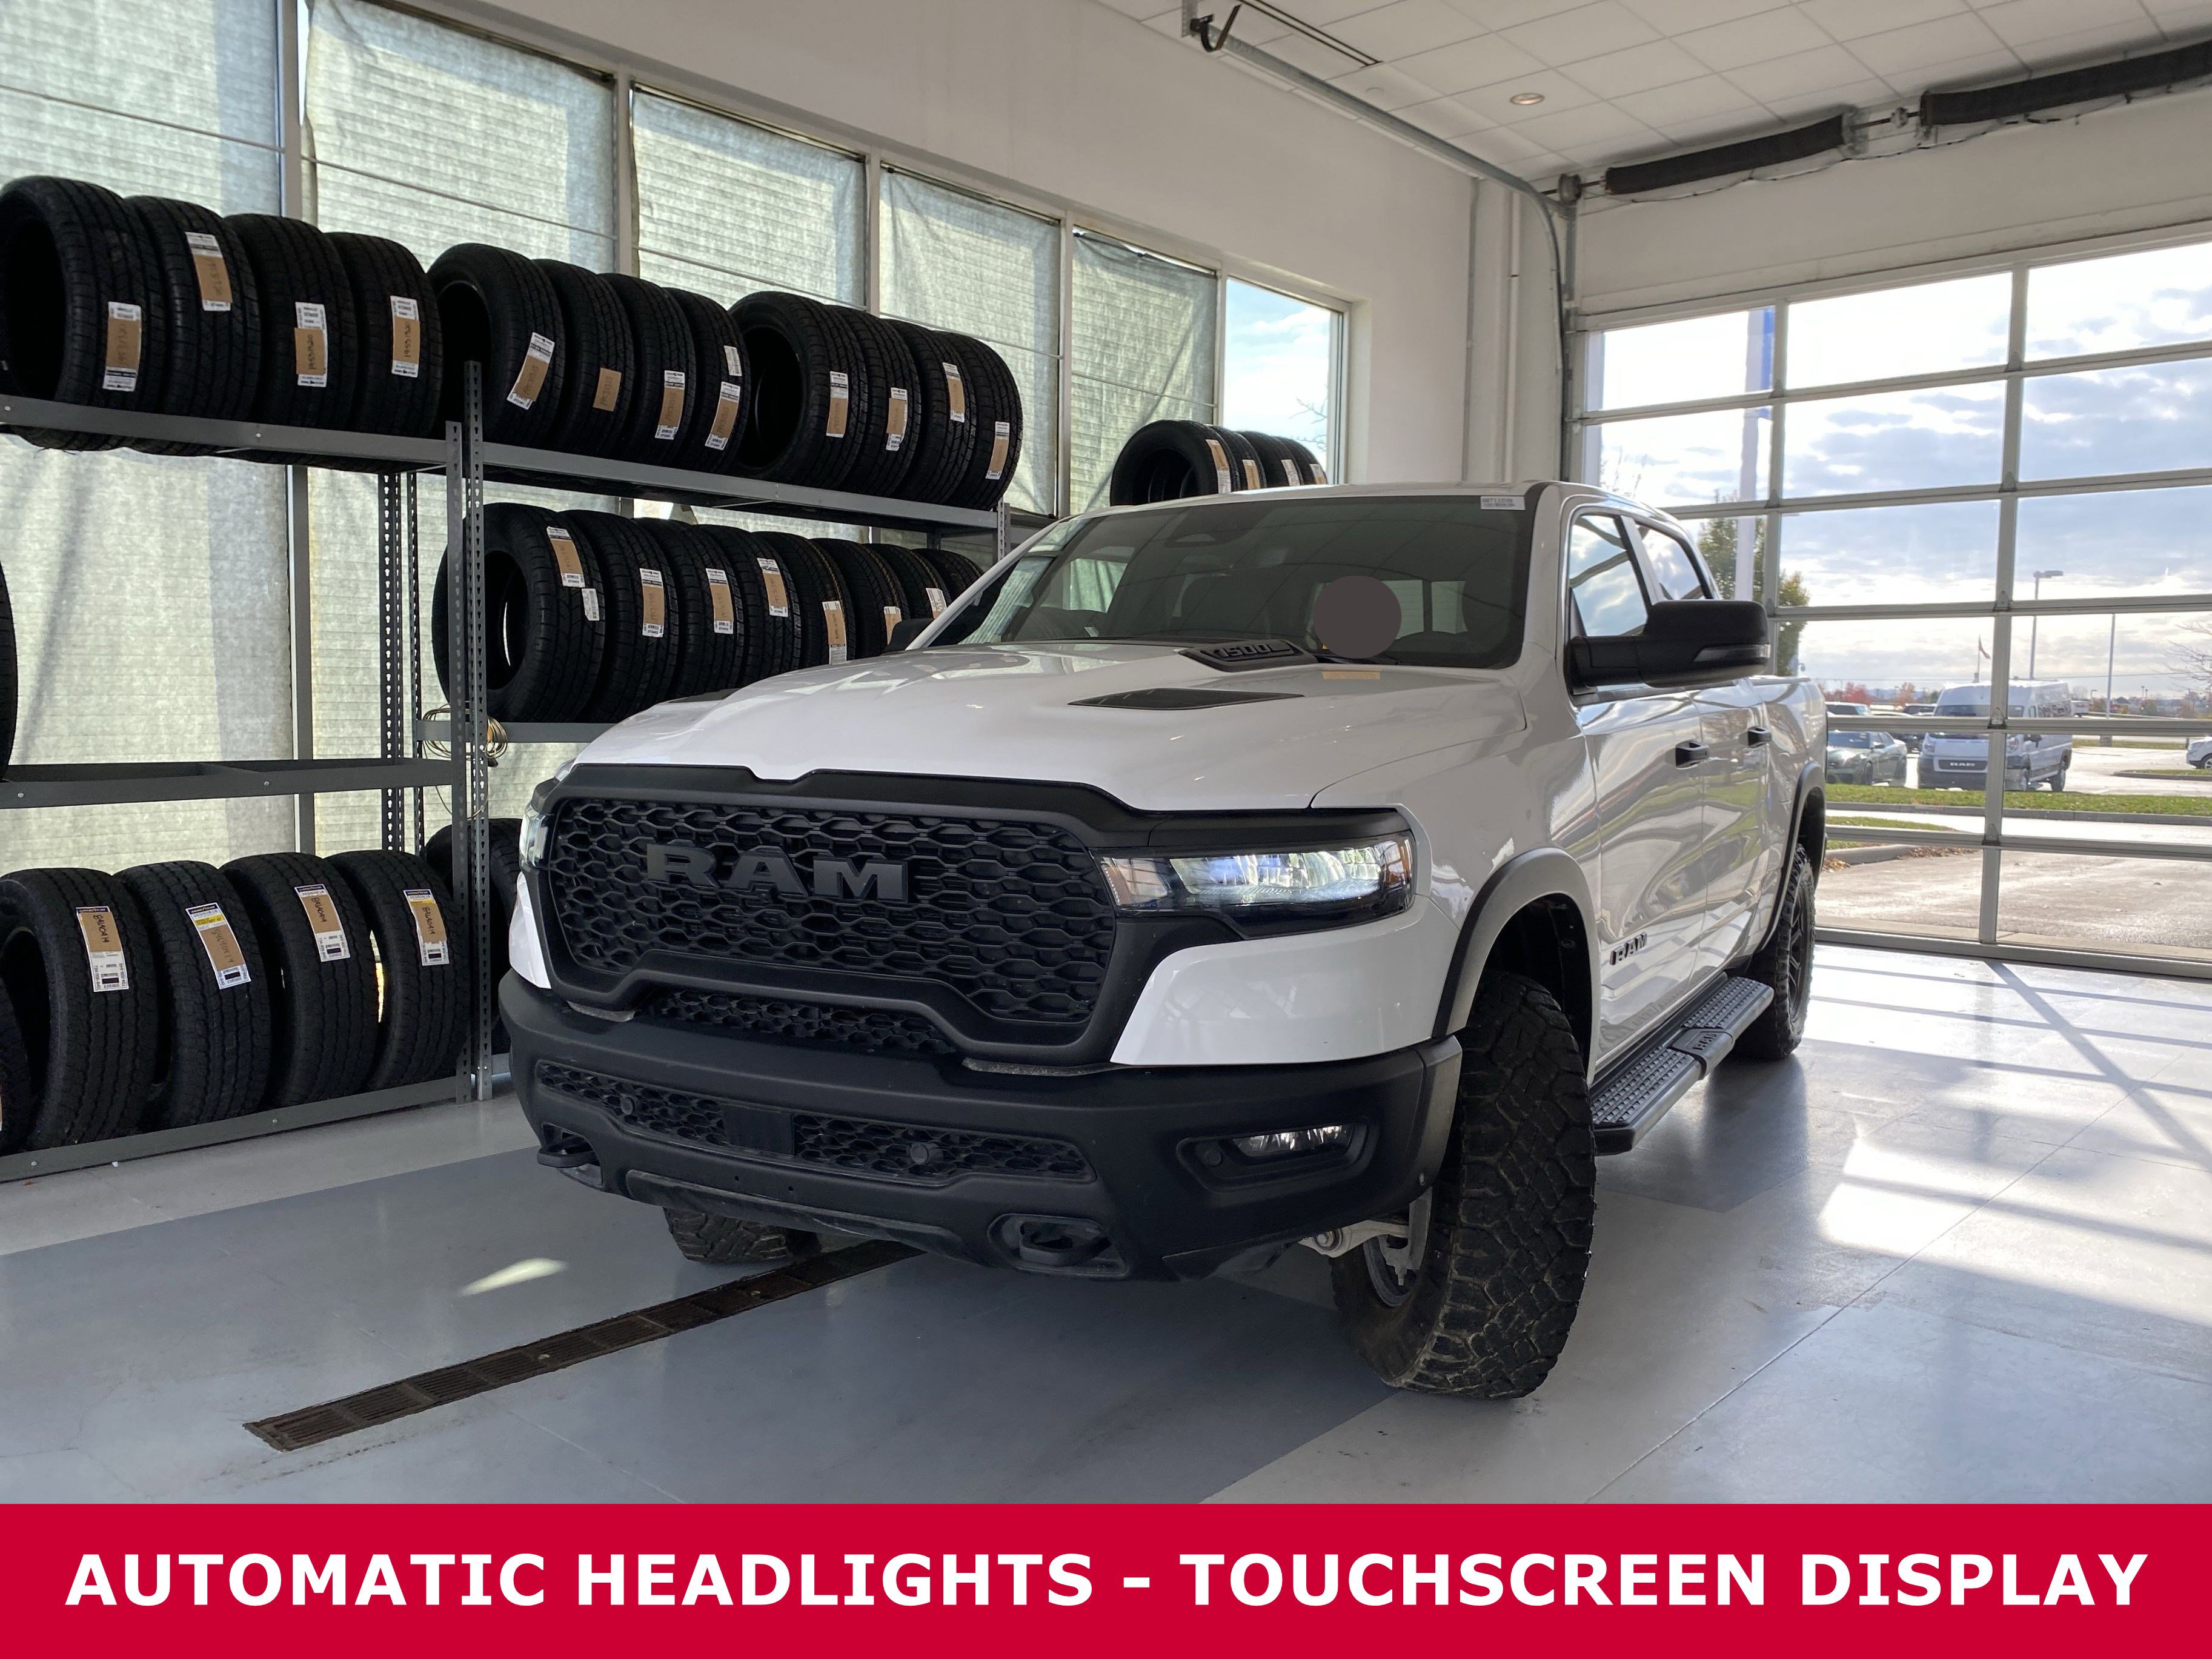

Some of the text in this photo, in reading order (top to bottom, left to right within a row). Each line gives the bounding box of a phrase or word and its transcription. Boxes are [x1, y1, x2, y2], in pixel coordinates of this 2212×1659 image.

[1214, 643, 1271, 658] 1500
[647, 844, 908, 903] RAM
[1609, 932, 1647, 965] RAM
